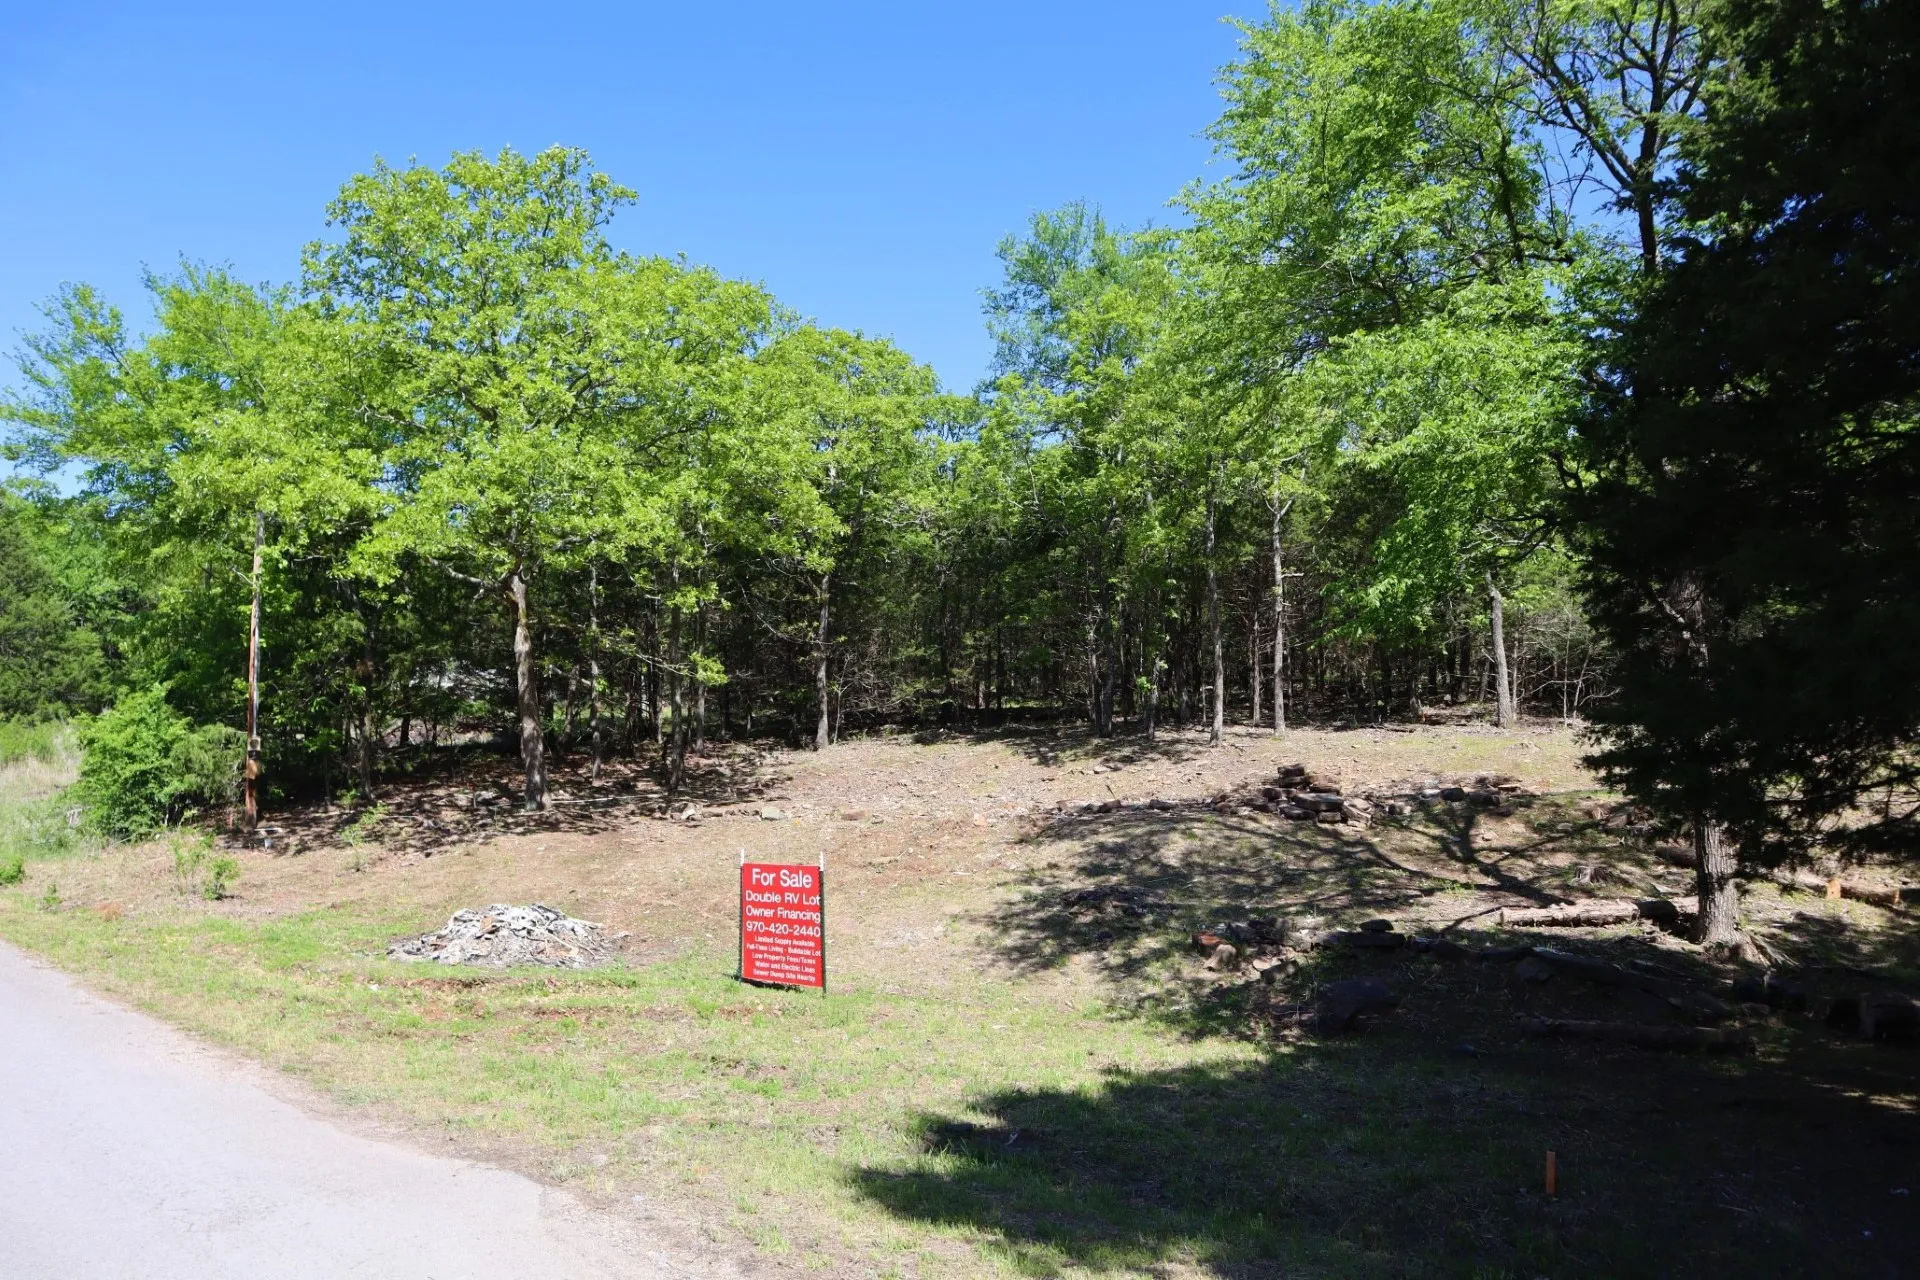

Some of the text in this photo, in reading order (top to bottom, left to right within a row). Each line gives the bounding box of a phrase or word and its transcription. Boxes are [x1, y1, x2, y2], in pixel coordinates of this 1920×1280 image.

[752, 869, 812, 888] For Sale
[746, 891, 820, 906] Double RV Lot
[746, 906, 820, 924] Owner Financing
[746, 921, 820, 937] 970-420-2440
[793, 939, 815, 947] Available
[764, 953, 785, 961] Property
